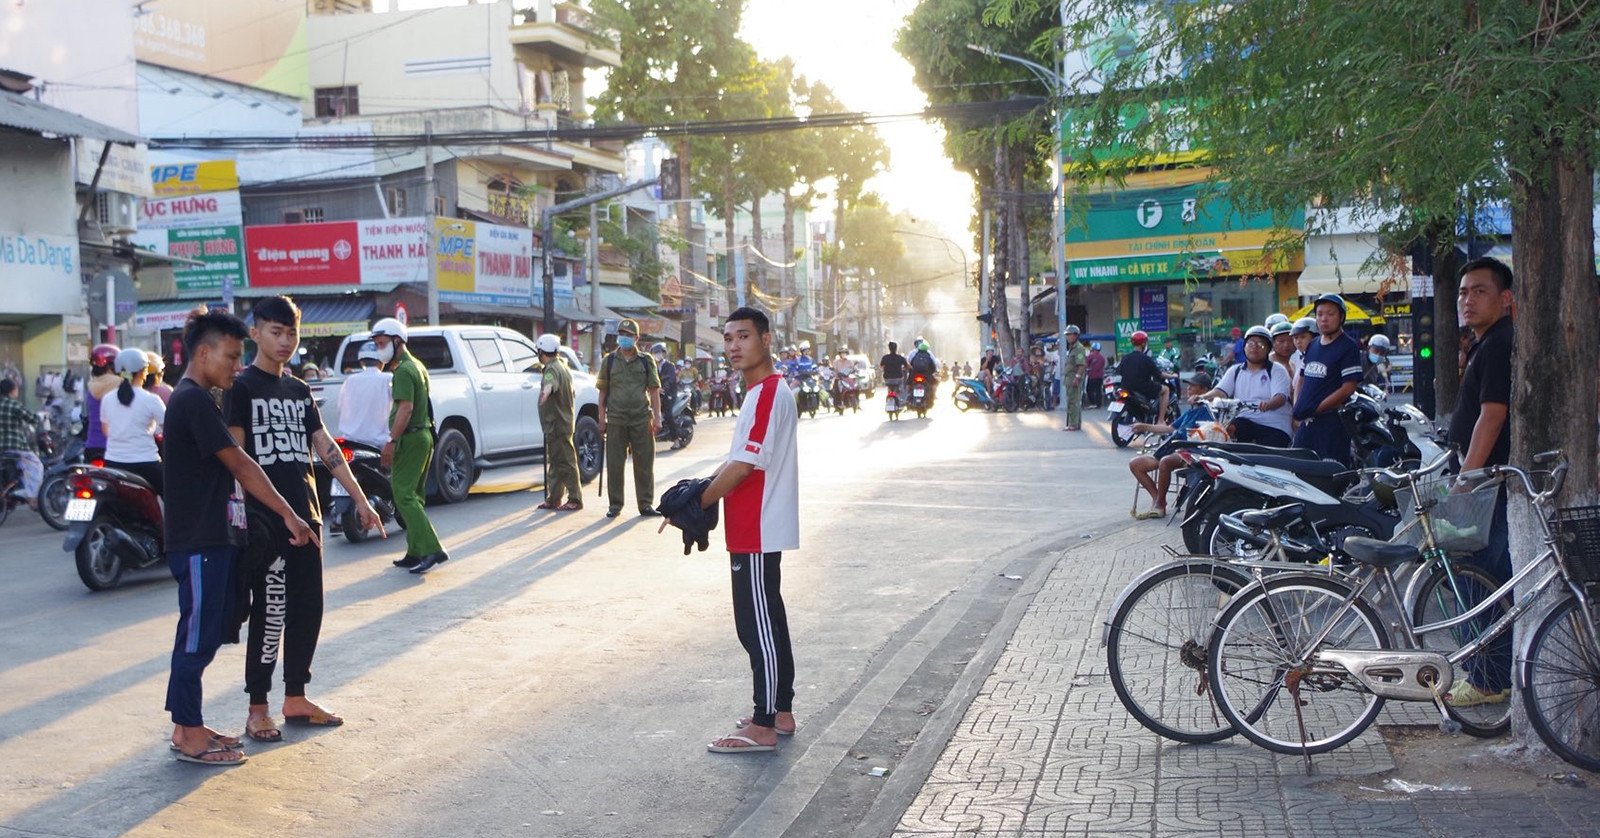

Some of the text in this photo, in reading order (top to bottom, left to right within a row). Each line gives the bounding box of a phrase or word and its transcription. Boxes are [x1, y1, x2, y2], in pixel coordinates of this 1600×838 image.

[362, 244, 403, 260] THANH
[438, 235, 474, 257] MPE
[289, 248, 330, 264] quang
[479, 250, 512, 276] THANH
[1074, 267, 1089, 278] VAY
[1089, 265, 1118, 278] NHANH
[1156, 262, 1168, 273] XE
[1152, 294, 1165, 303] MB
[1117, 322, 1139, 334] VAY
[260, 573, 286, 664] DSQUARED2
